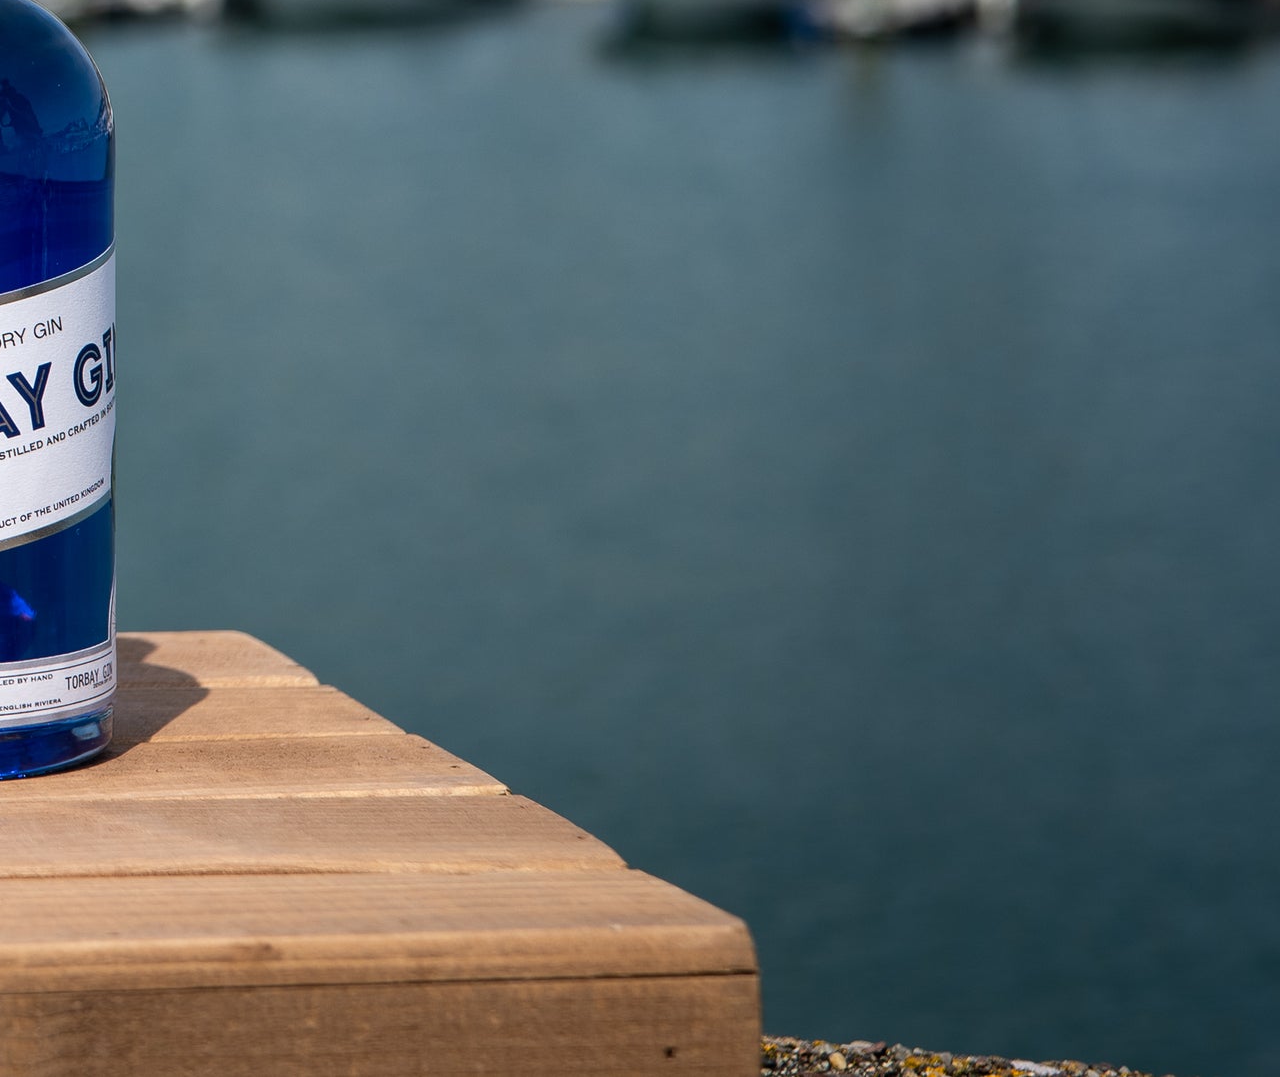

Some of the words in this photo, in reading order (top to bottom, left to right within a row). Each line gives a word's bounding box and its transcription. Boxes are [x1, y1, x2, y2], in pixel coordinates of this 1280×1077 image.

[33, 316, 63, 339] GIN
[46, 431, 66, 447] AND
[68, 413, 100, 437] CRAFTED
[20, 512, 32, 522] OF
[34, 506, 52, 517] THE
[53, 494, 80, 511] UNITED
[80, 477, 105, 498] KINGDOM
[30, 673, 54, 682] HAND
[65, 668, 99, 691] TORBAY
[34, 698, 62, 707] RIVIERA
